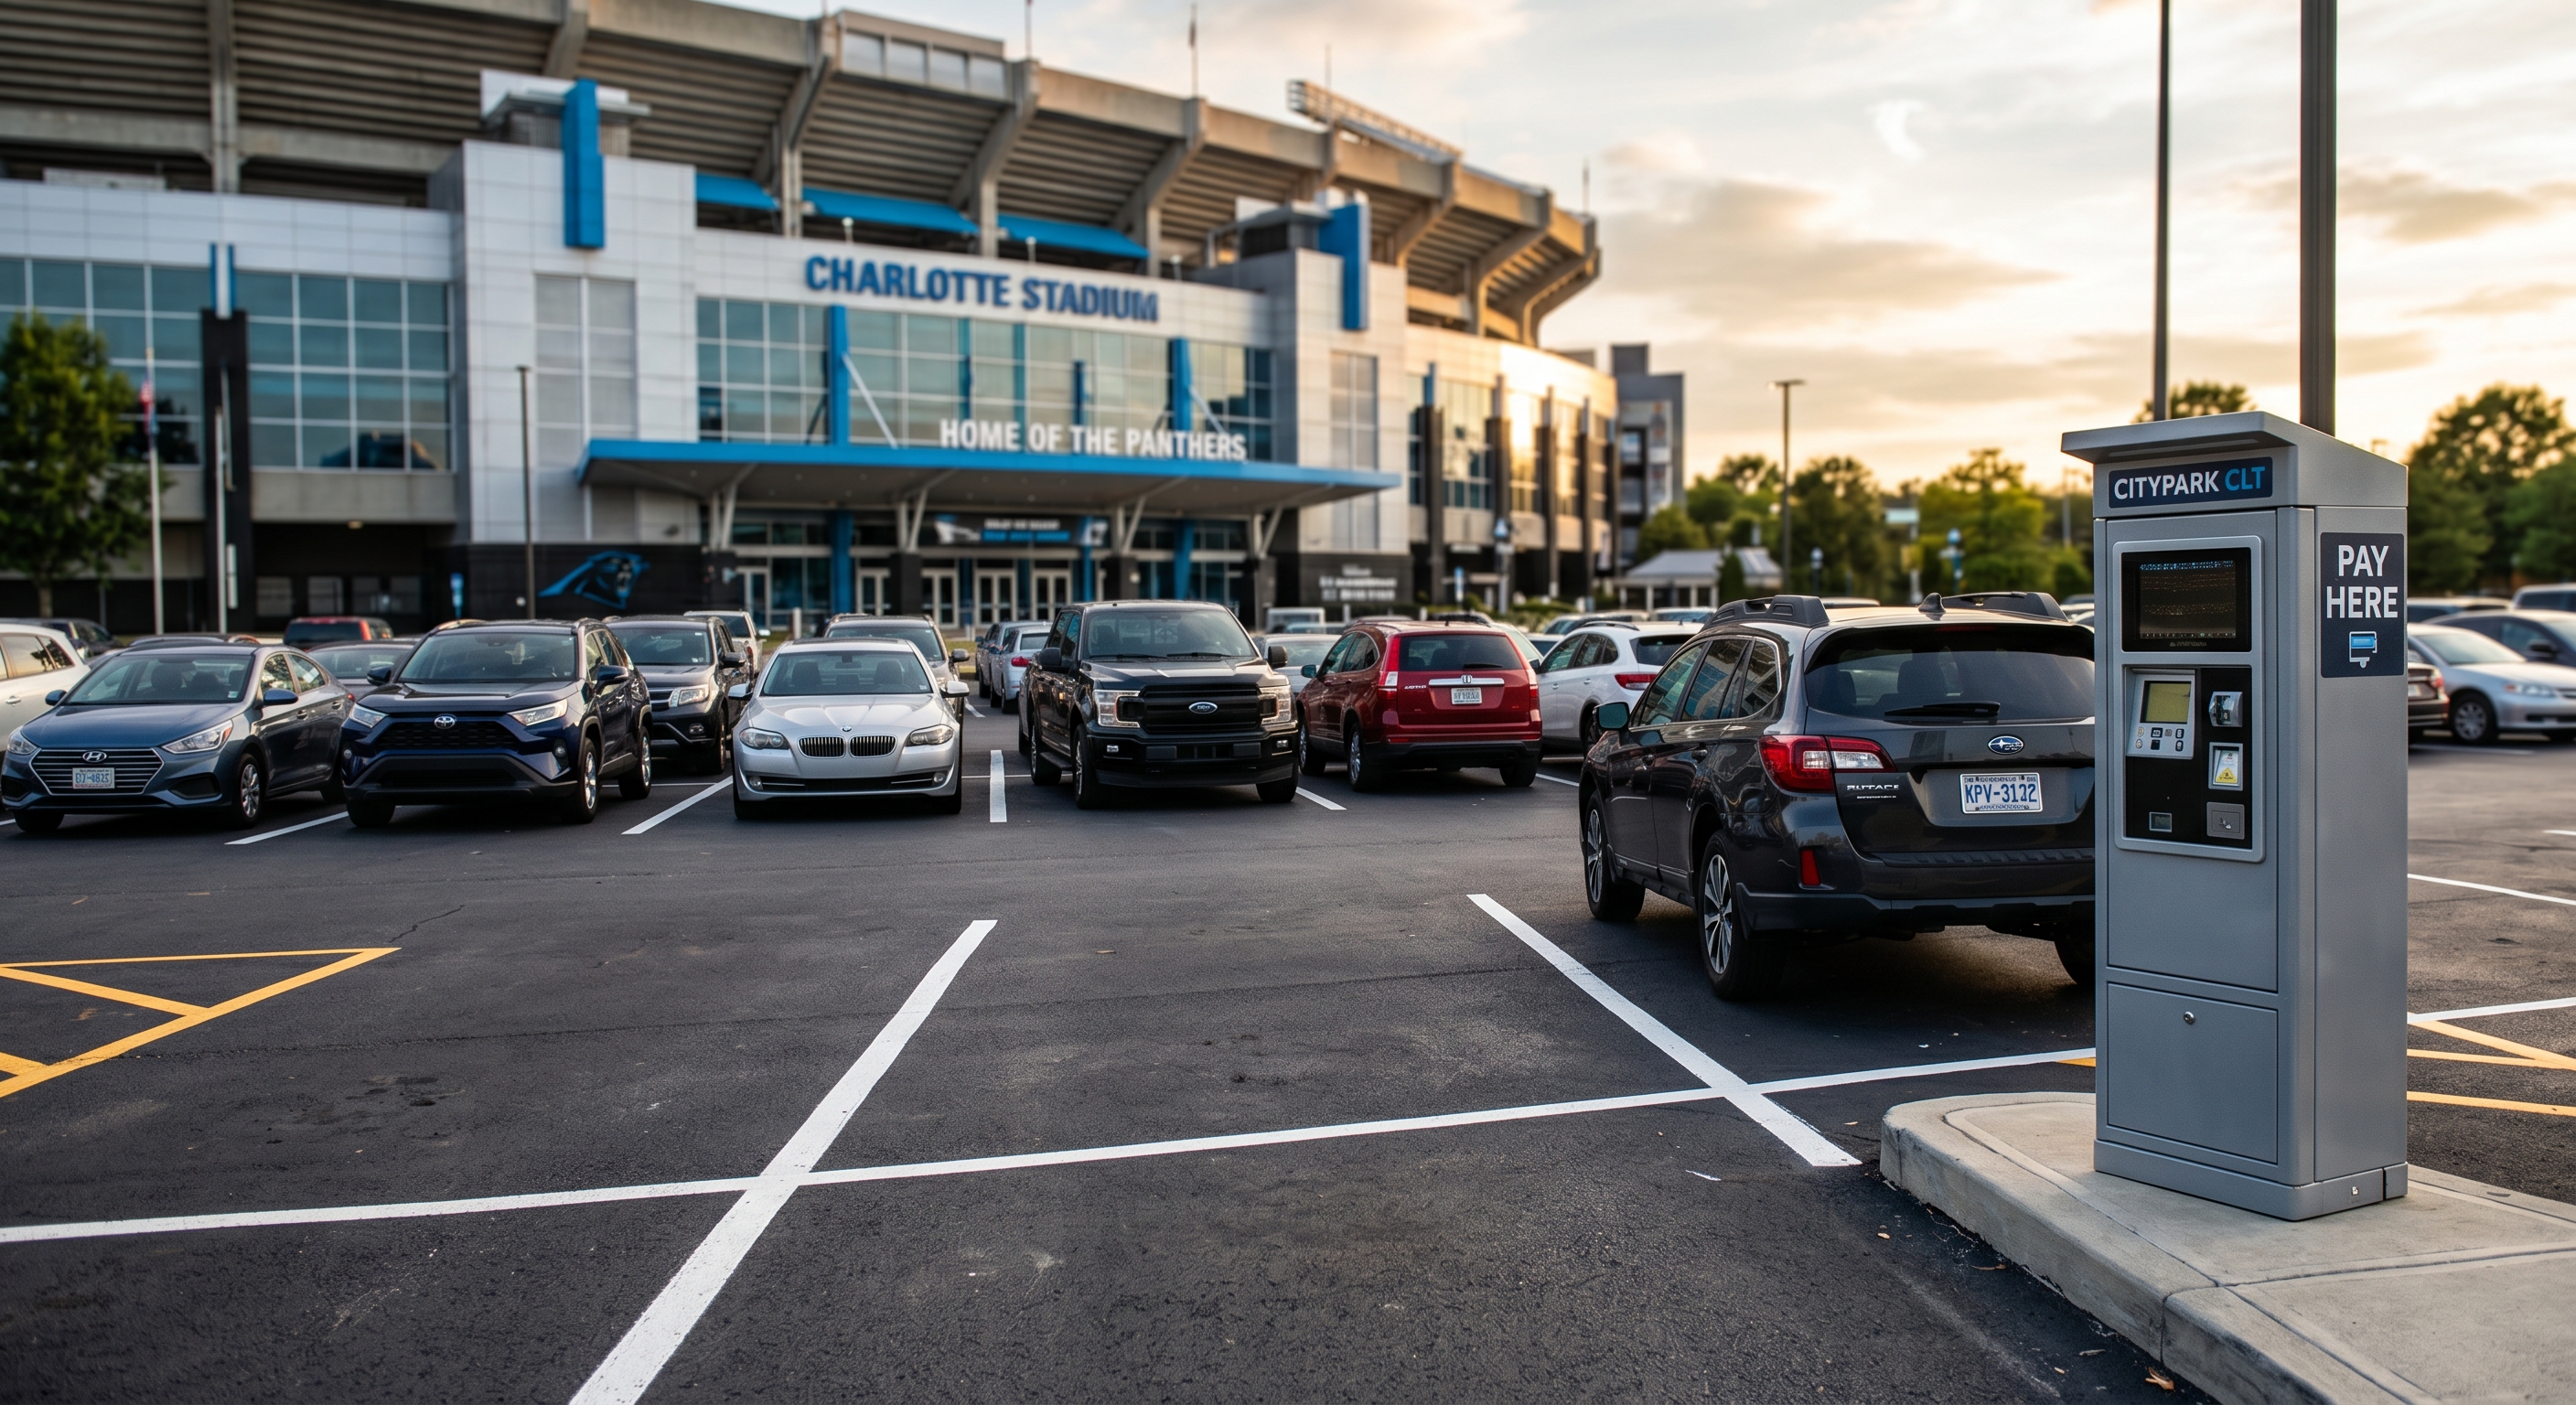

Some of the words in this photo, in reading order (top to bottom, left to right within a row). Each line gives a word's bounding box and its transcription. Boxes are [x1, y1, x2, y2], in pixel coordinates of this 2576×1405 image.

[805, 255, 1012, 308] CHARLOTTE
[1021, 279, 1159, 322] STADIUM
[939, 418, 1021, 452] HOME
[1027, 423, 1063, 453] OF
[1068, 425, 1120, 456] THE
[1123, 430, 1248, 462] PANTHERS
[2113, 469, 2221, 500] CITYPARK
[2224, 466, 2267, 492] CLT
[2337, 544, 2390, 577] PAY
[2325, 585, 2399, 620] HERE
